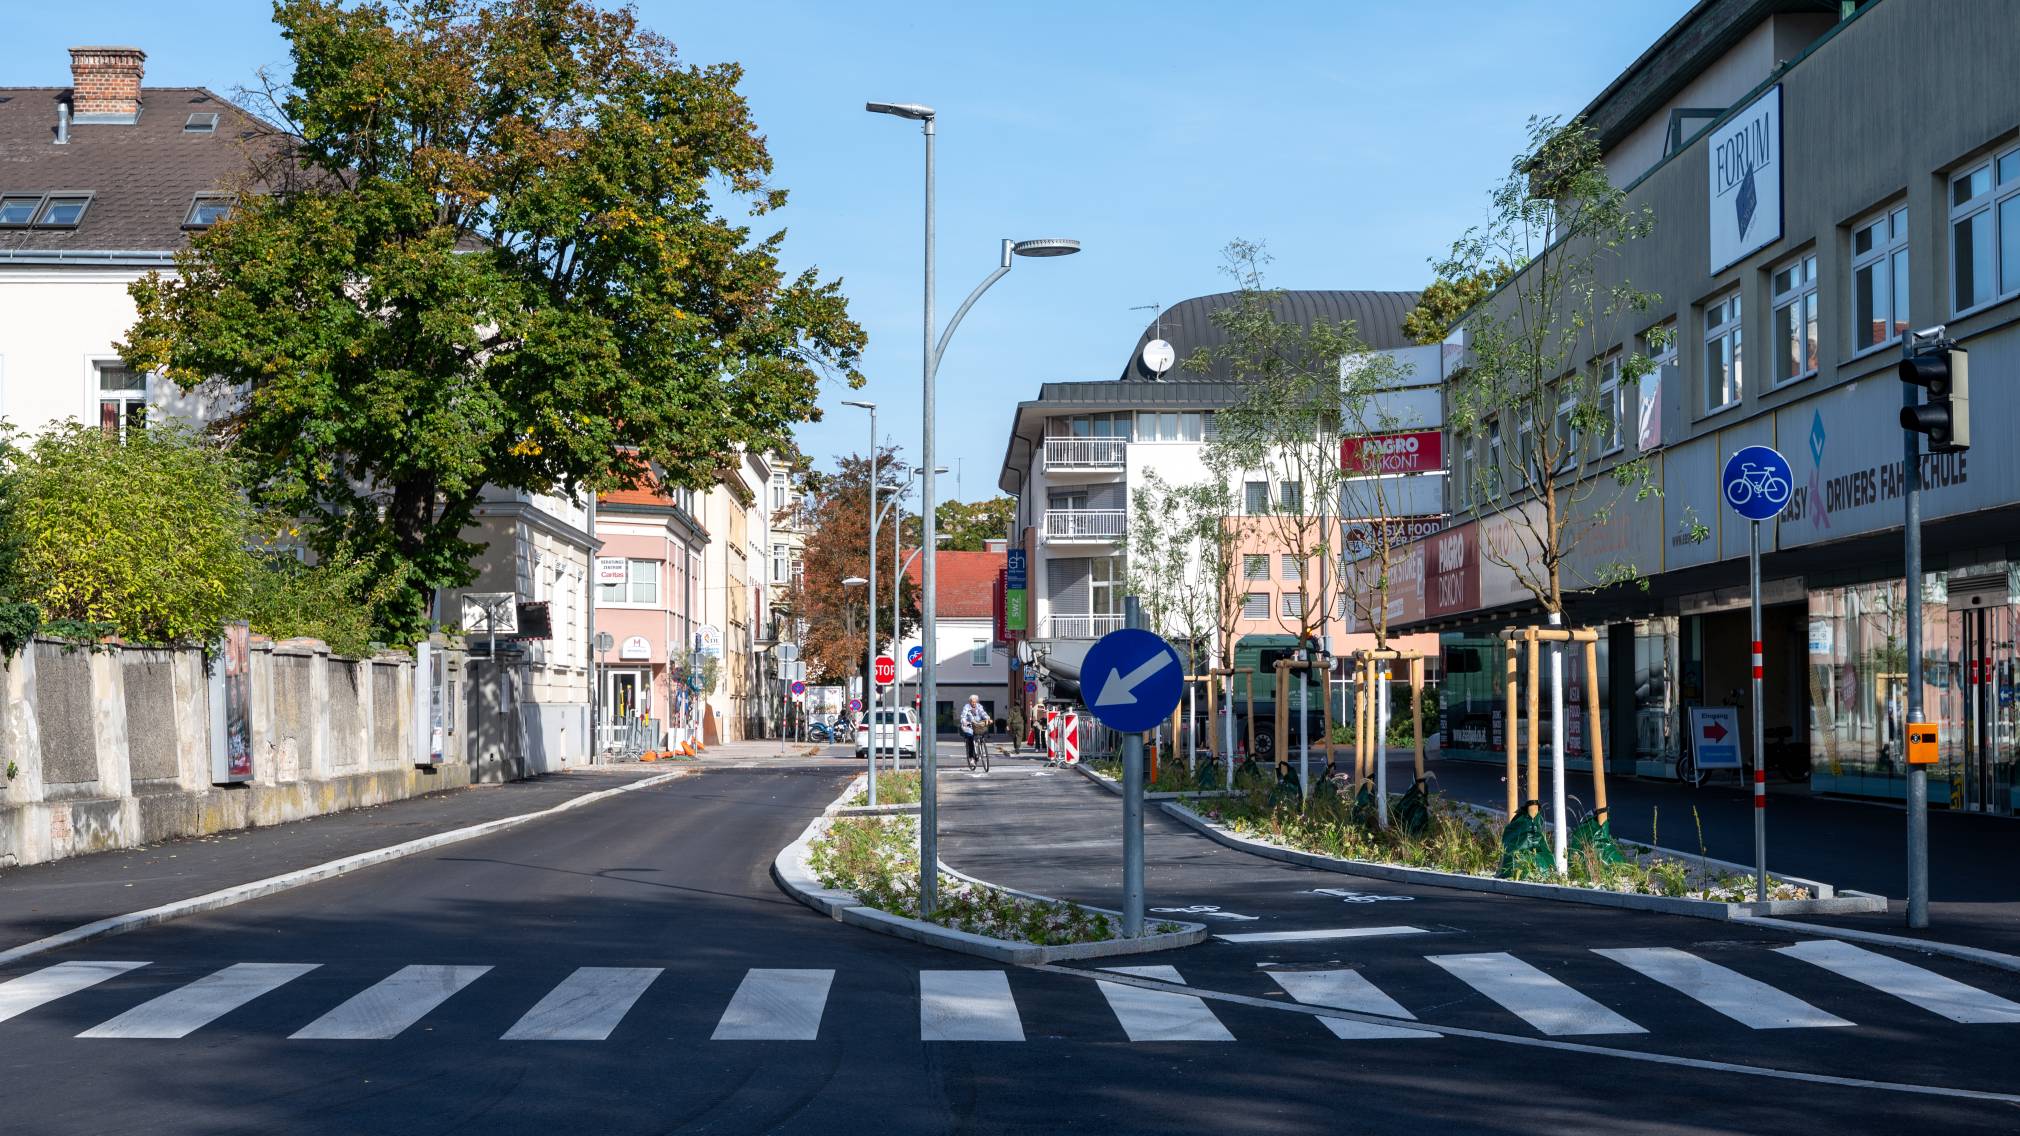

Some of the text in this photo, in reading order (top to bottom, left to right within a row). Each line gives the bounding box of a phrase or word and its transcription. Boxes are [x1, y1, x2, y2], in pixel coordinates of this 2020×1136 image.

[1716, 112, 1769, 192] FORUM
[1363, 437, 1419, 455] PAGRO
[1826, 467, 1876, 513] DRIVERS
[1880, 450, 1967, 500] FAHCHULE
[1407, 522, 1440, 536] FOOD
[1439, 533, 1464, 573] PAGRO
[1439, 571, 1465, 607] DISKONT
[1569, 705, 1580, 718] FOOD
[1701, 712, 1728, 720] Eingang
